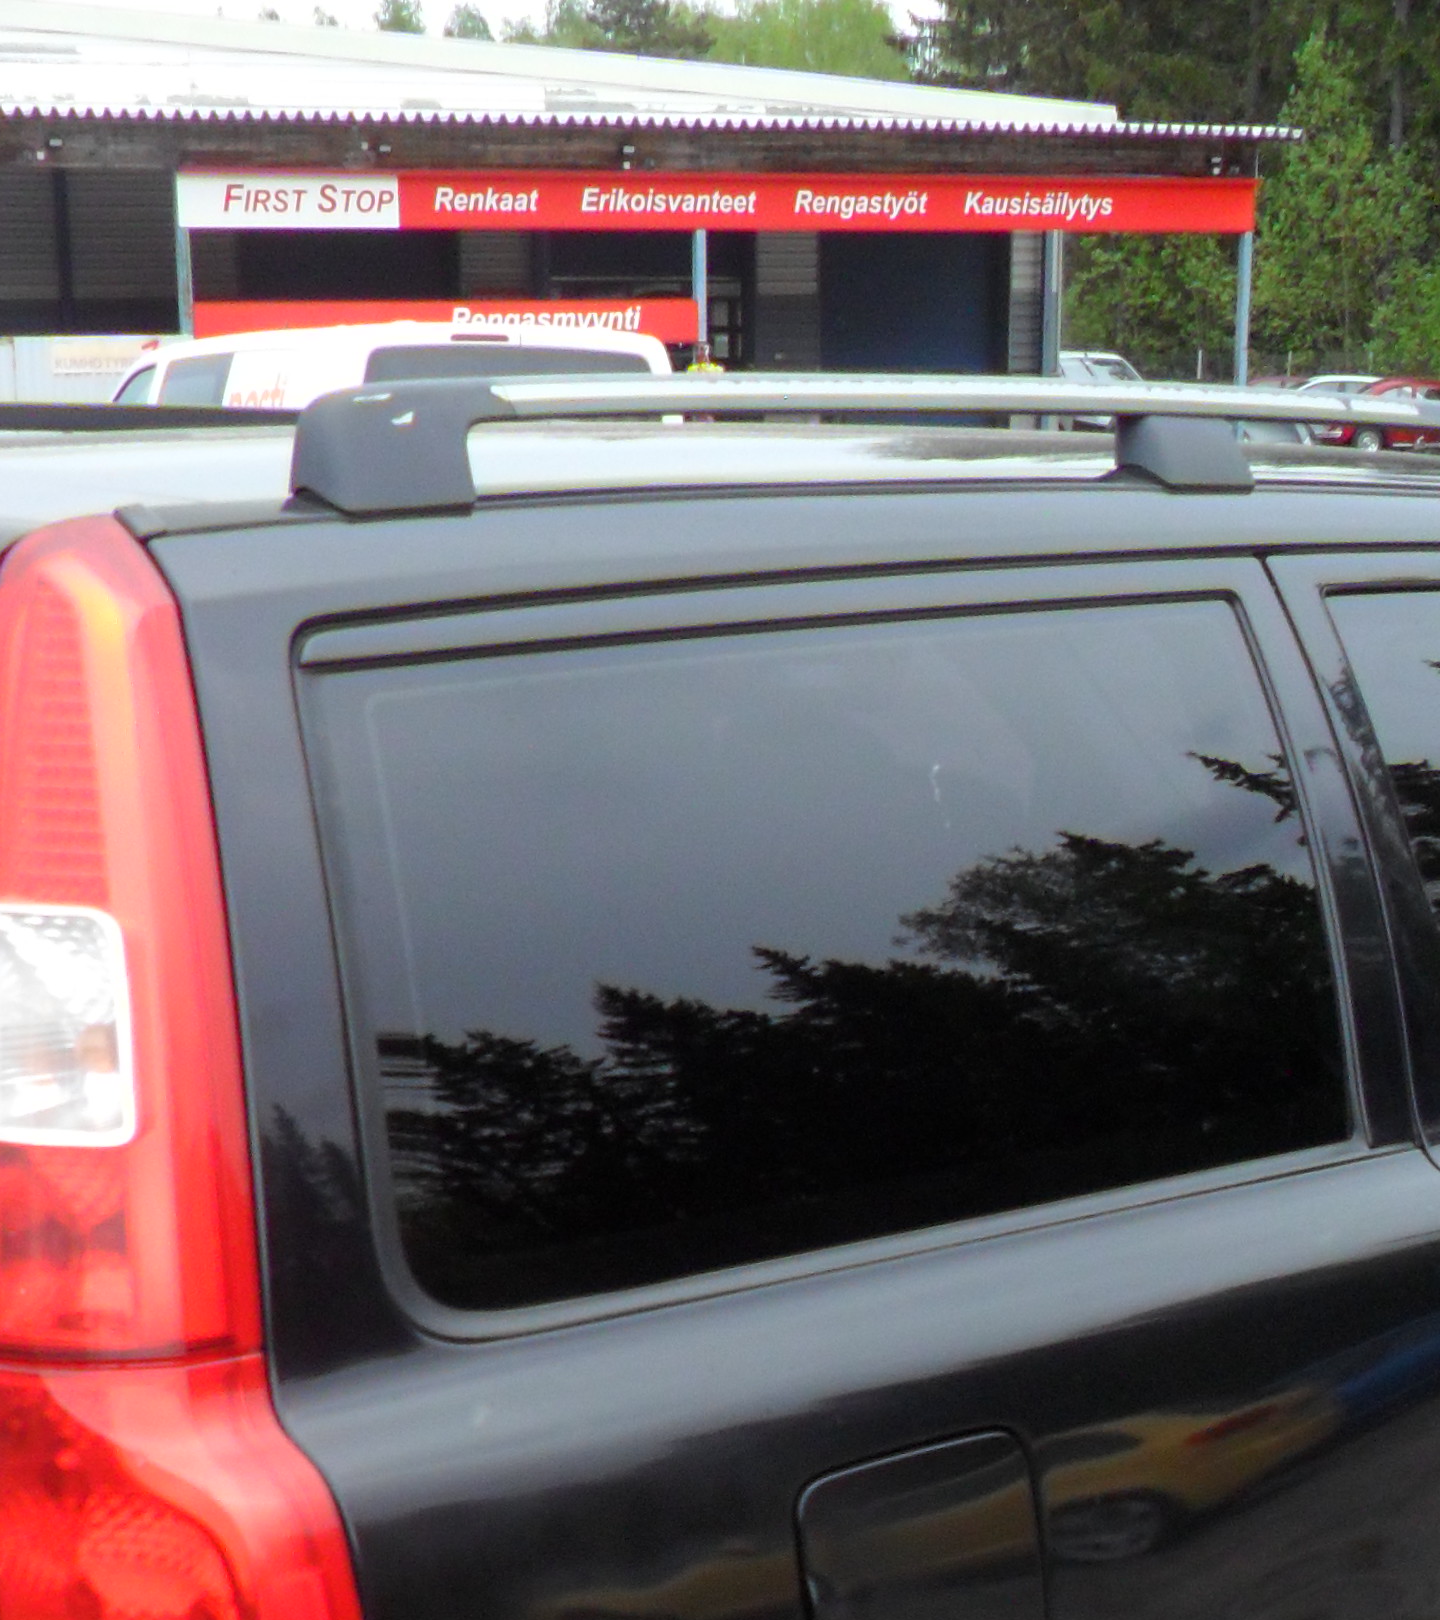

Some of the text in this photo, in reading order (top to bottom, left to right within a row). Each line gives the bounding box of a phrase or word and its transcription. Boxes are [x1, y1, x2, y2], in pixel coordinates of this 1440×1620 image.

[223, 184, 395, 213] FIRST STOP
[434, 187, 1113, 221] Renkaat Erikoisvanteet Rengastyöt Kausisäilytys
